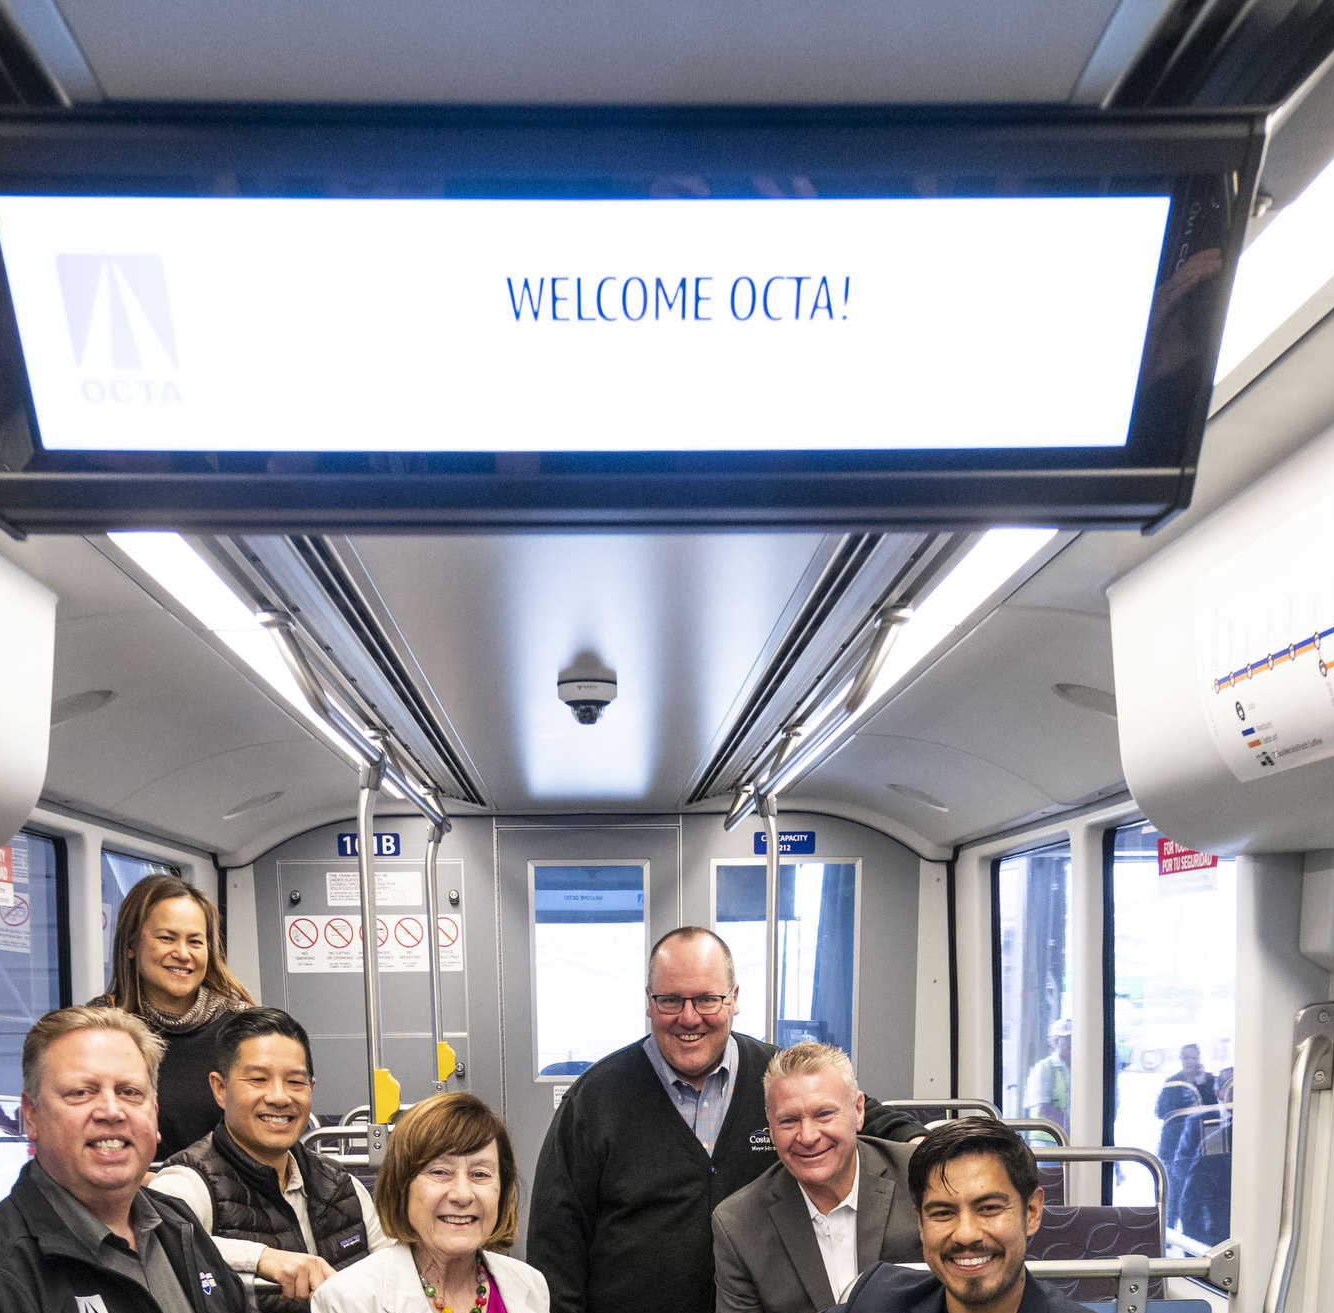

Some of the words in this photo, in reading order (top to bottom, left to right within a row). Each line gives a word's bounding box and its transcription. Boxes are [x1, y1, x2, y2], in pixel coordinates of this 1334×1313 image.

[506, 276, 713, 322] WELCOME
[729, 275, 851, 322] OCTA!
[81, 378, 184, 405] OCTA
[342, 835, 397, 855] 11B
[1173, 857, 1180, 870] TU
